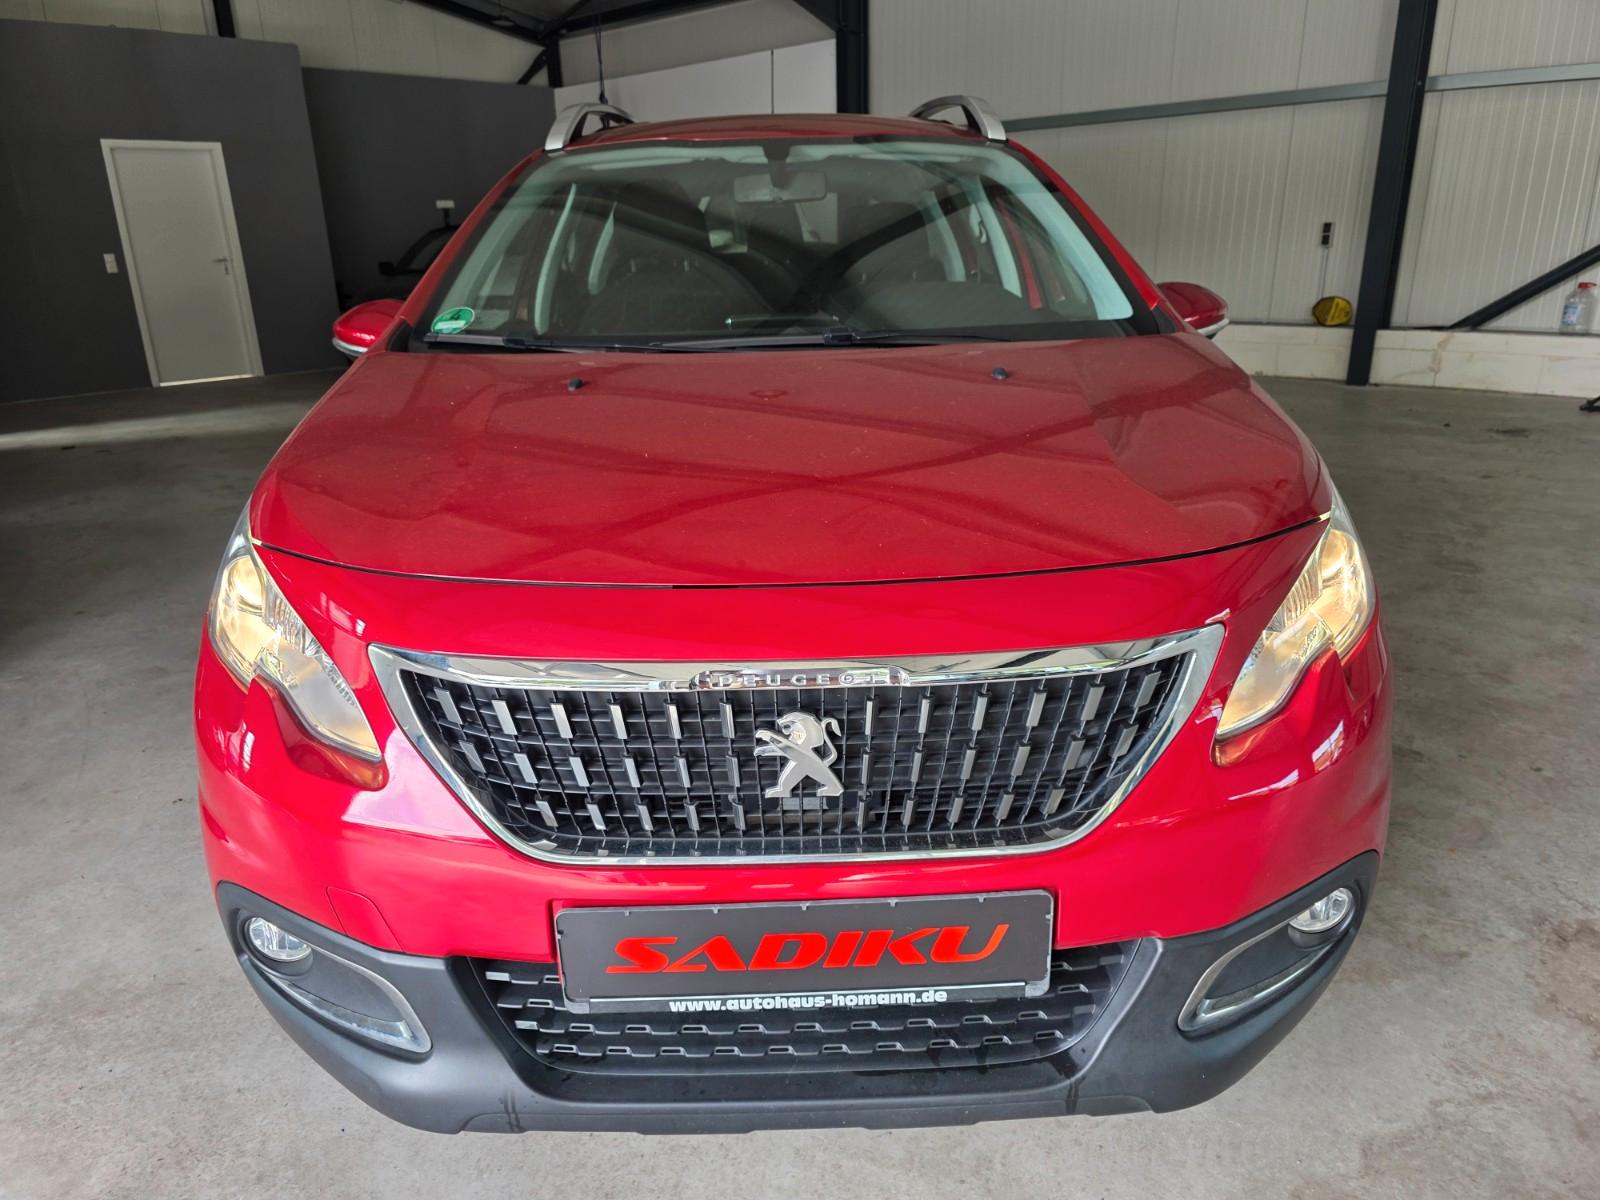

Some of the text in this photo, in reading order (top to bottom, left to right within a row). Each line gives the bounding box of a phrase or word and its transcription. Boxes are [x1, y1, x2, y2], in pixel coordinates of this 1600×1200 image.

[719, 672, 881, 688] PEUGEOT
[606, 924, 1010, 974] SADIKU
[668, 989, 948, 1013] www.autohaus-homann.de
